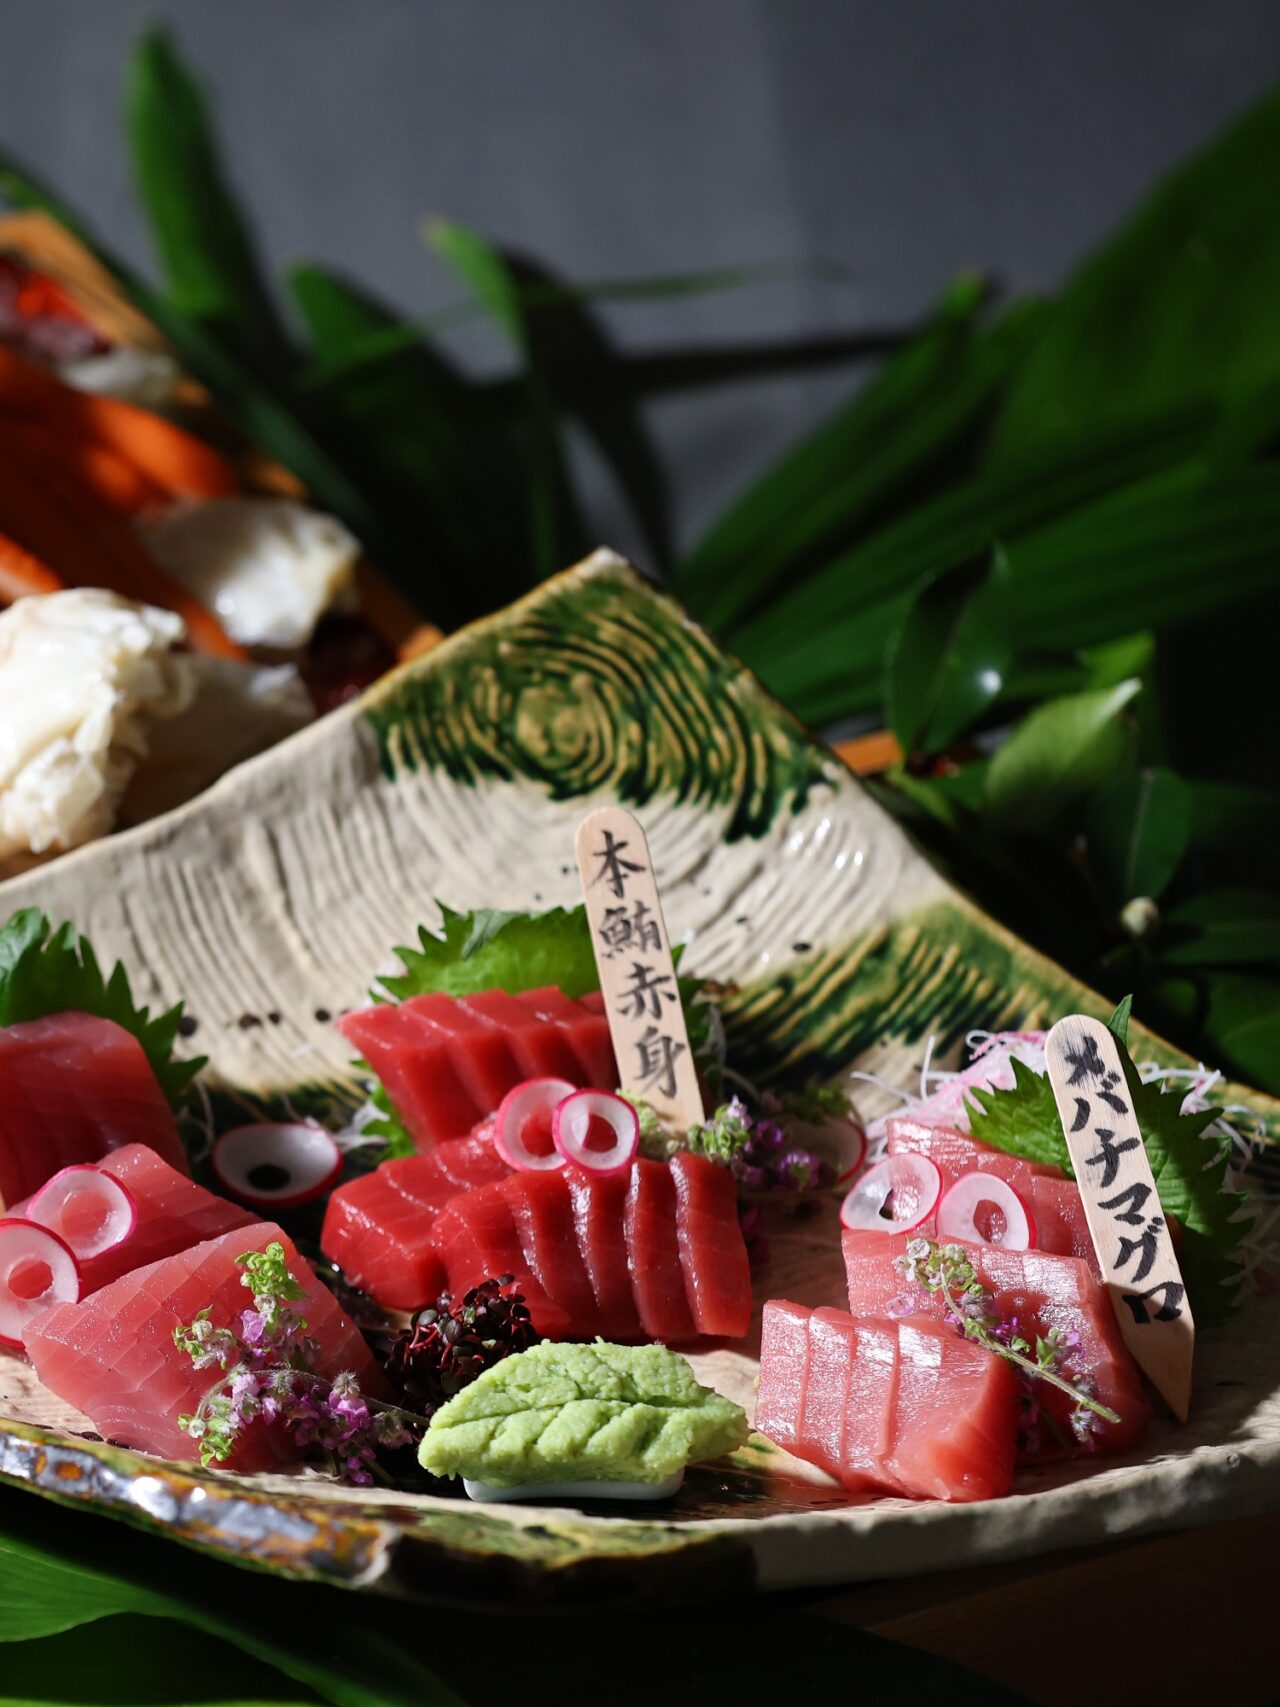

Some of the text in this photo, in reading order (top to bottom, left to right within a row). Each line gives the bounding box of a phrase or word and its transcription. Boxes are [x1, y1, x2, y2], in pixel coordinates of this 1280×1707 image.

[588, 829, 686, 1100] 本鮪赤身
[1064, 1035, 1184, 1324] メバチマグロ
